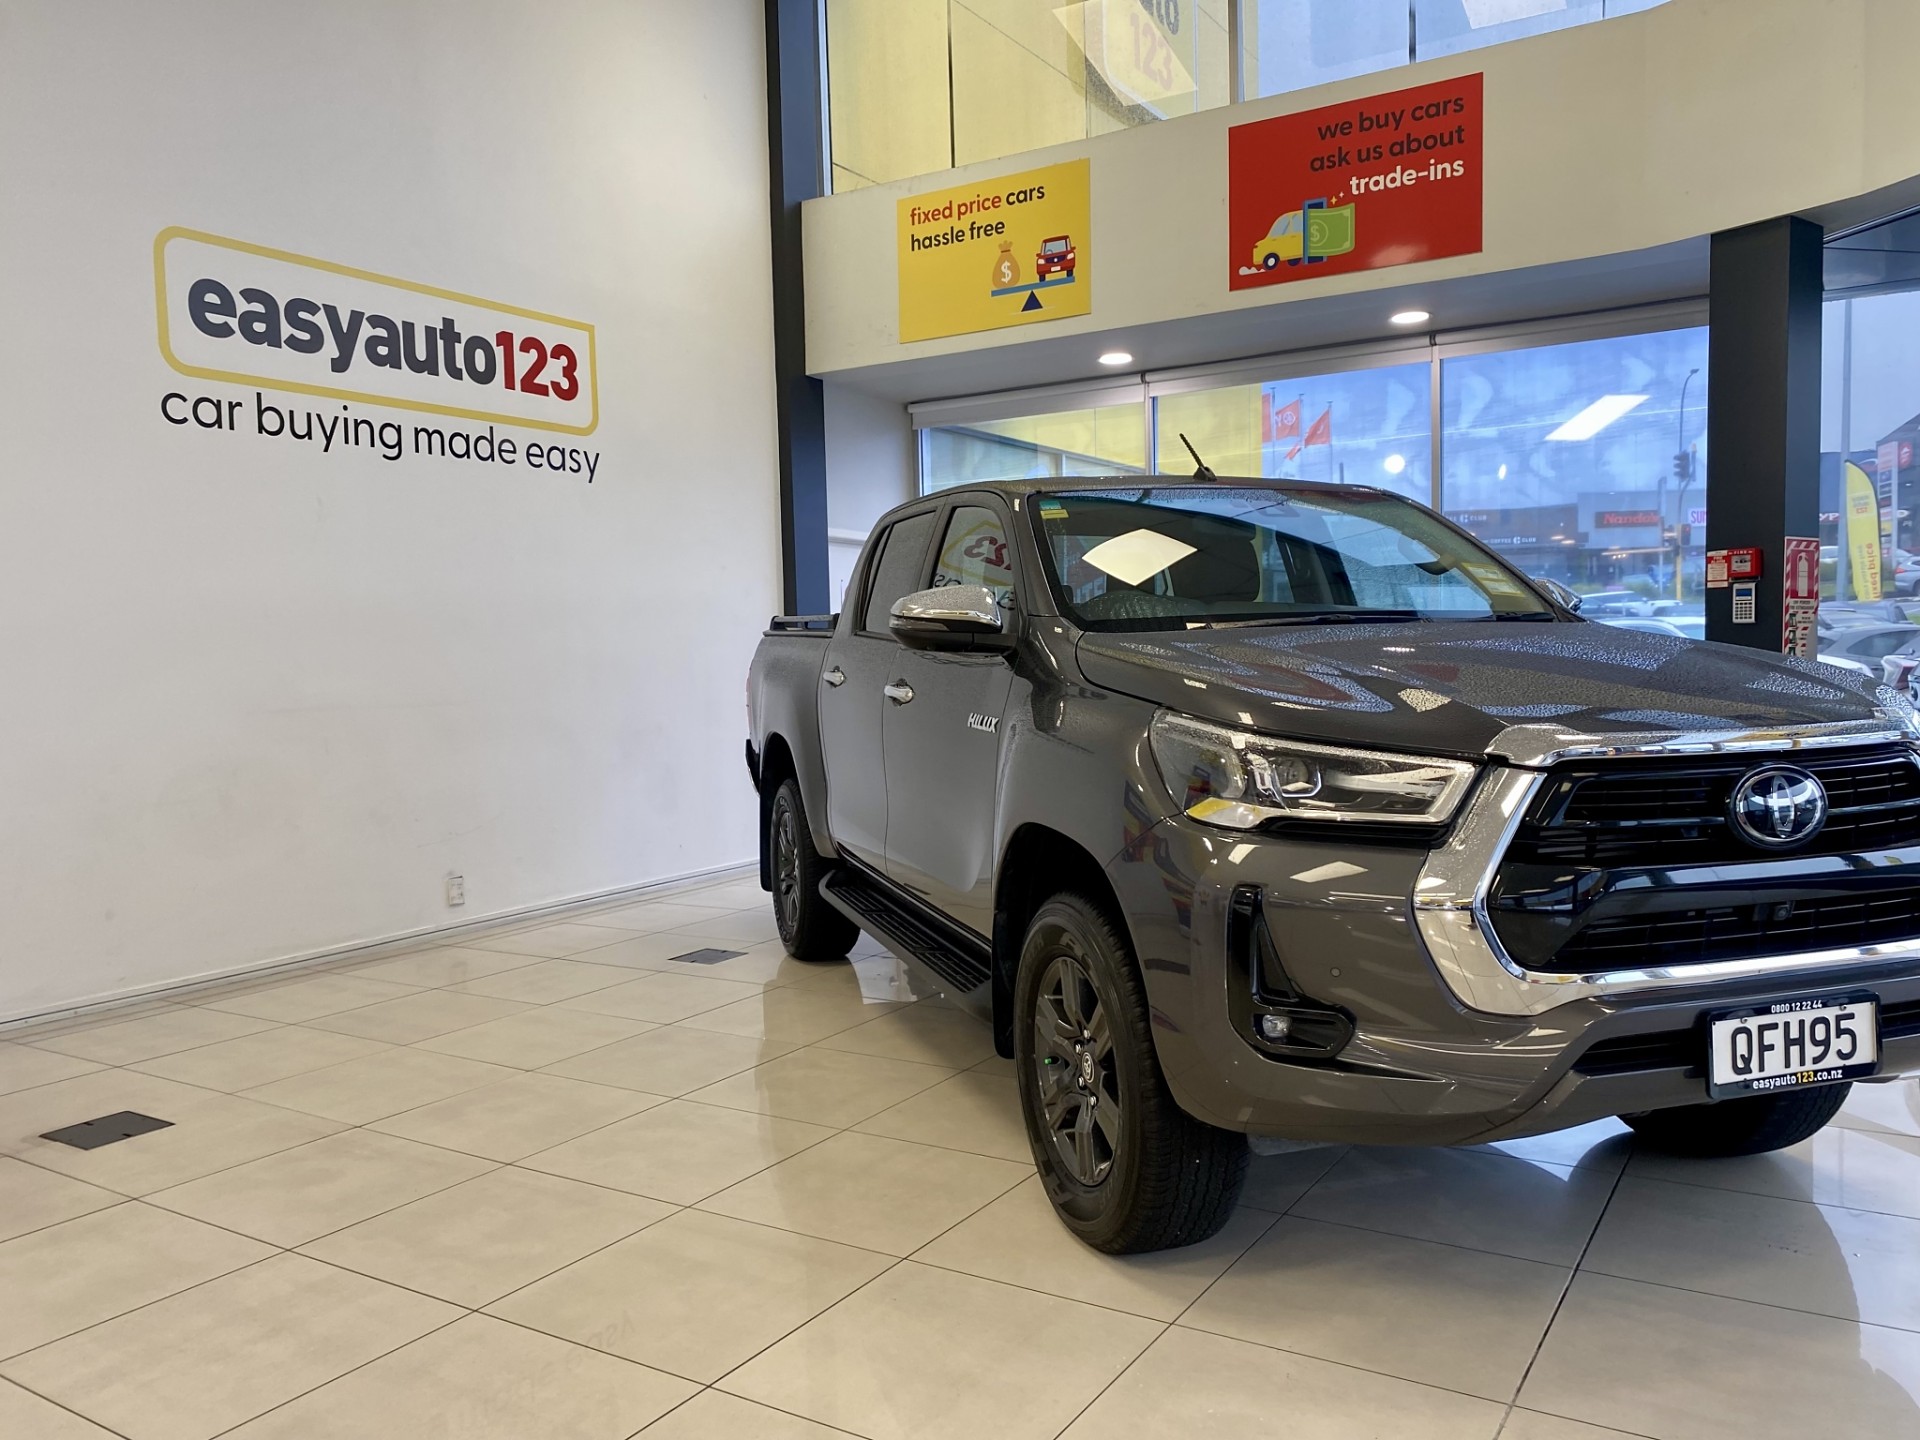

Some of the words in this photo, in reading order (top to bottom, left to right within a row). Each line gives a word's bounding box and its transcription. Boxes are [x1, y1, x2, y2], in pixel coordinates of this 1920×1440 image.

[1317, 120, 1353, 141] we
[1359, 109, 1405, 134] buy
[1411, 97, 1465, 121] cars
[1309, 146, 1351, 172] ask
[1357, 144, 1383, 164] us
[1388, 125, 1465, 157] about
[1349, 158, 1465, 196] trade-ins
[910, 200, 953, 226] fixed
[957, 194, 1002, 221] price
[1006, 185, 1045, 206] cars
[910, 225, 966, 252] hassle
[969, 221, 1006, 240] free
[187, 277, 580, 402] easyauto123
[160, 391, 242, 432] car
[256, 392, 402, 460] buying
[413, 426, 517, 465] made
[525, 444, 600, 484] easy
[967, 712, 1000, 734] HILUX
[1771, 1004, 1789, 1014] 0800
[1791, 1002, 1801, 1012] 12
[1801, 1001, 1812, 1010] 22
[1812, 999, 1823, 1009] 44
[1731, 1012, 1857, 1075] QFH95
[1752, 1068, 1843, 1090] easyauto123.co.nz
